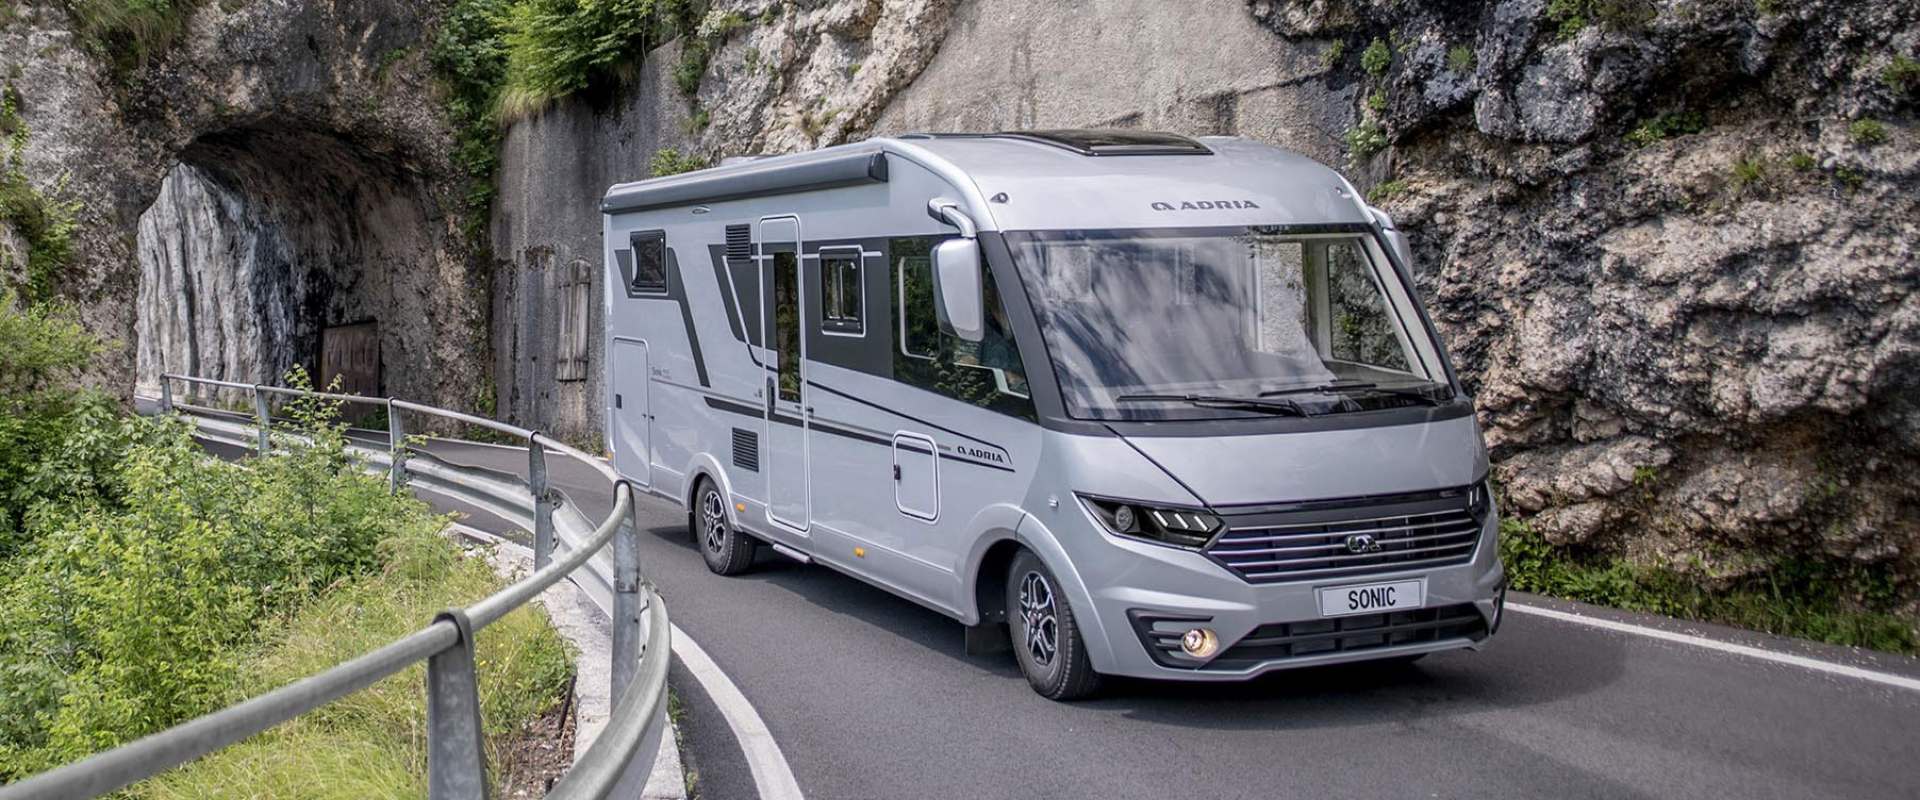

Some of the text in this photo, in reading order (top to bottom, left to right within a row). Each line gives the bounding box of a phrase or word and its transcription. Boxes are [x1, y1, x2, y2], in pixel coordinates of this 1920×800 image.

[1180, 200, 1260, 210] ADRIA
[968, 448, 1004, 463] ADRIA
[1348, 586, 1396, 610] SONIC
